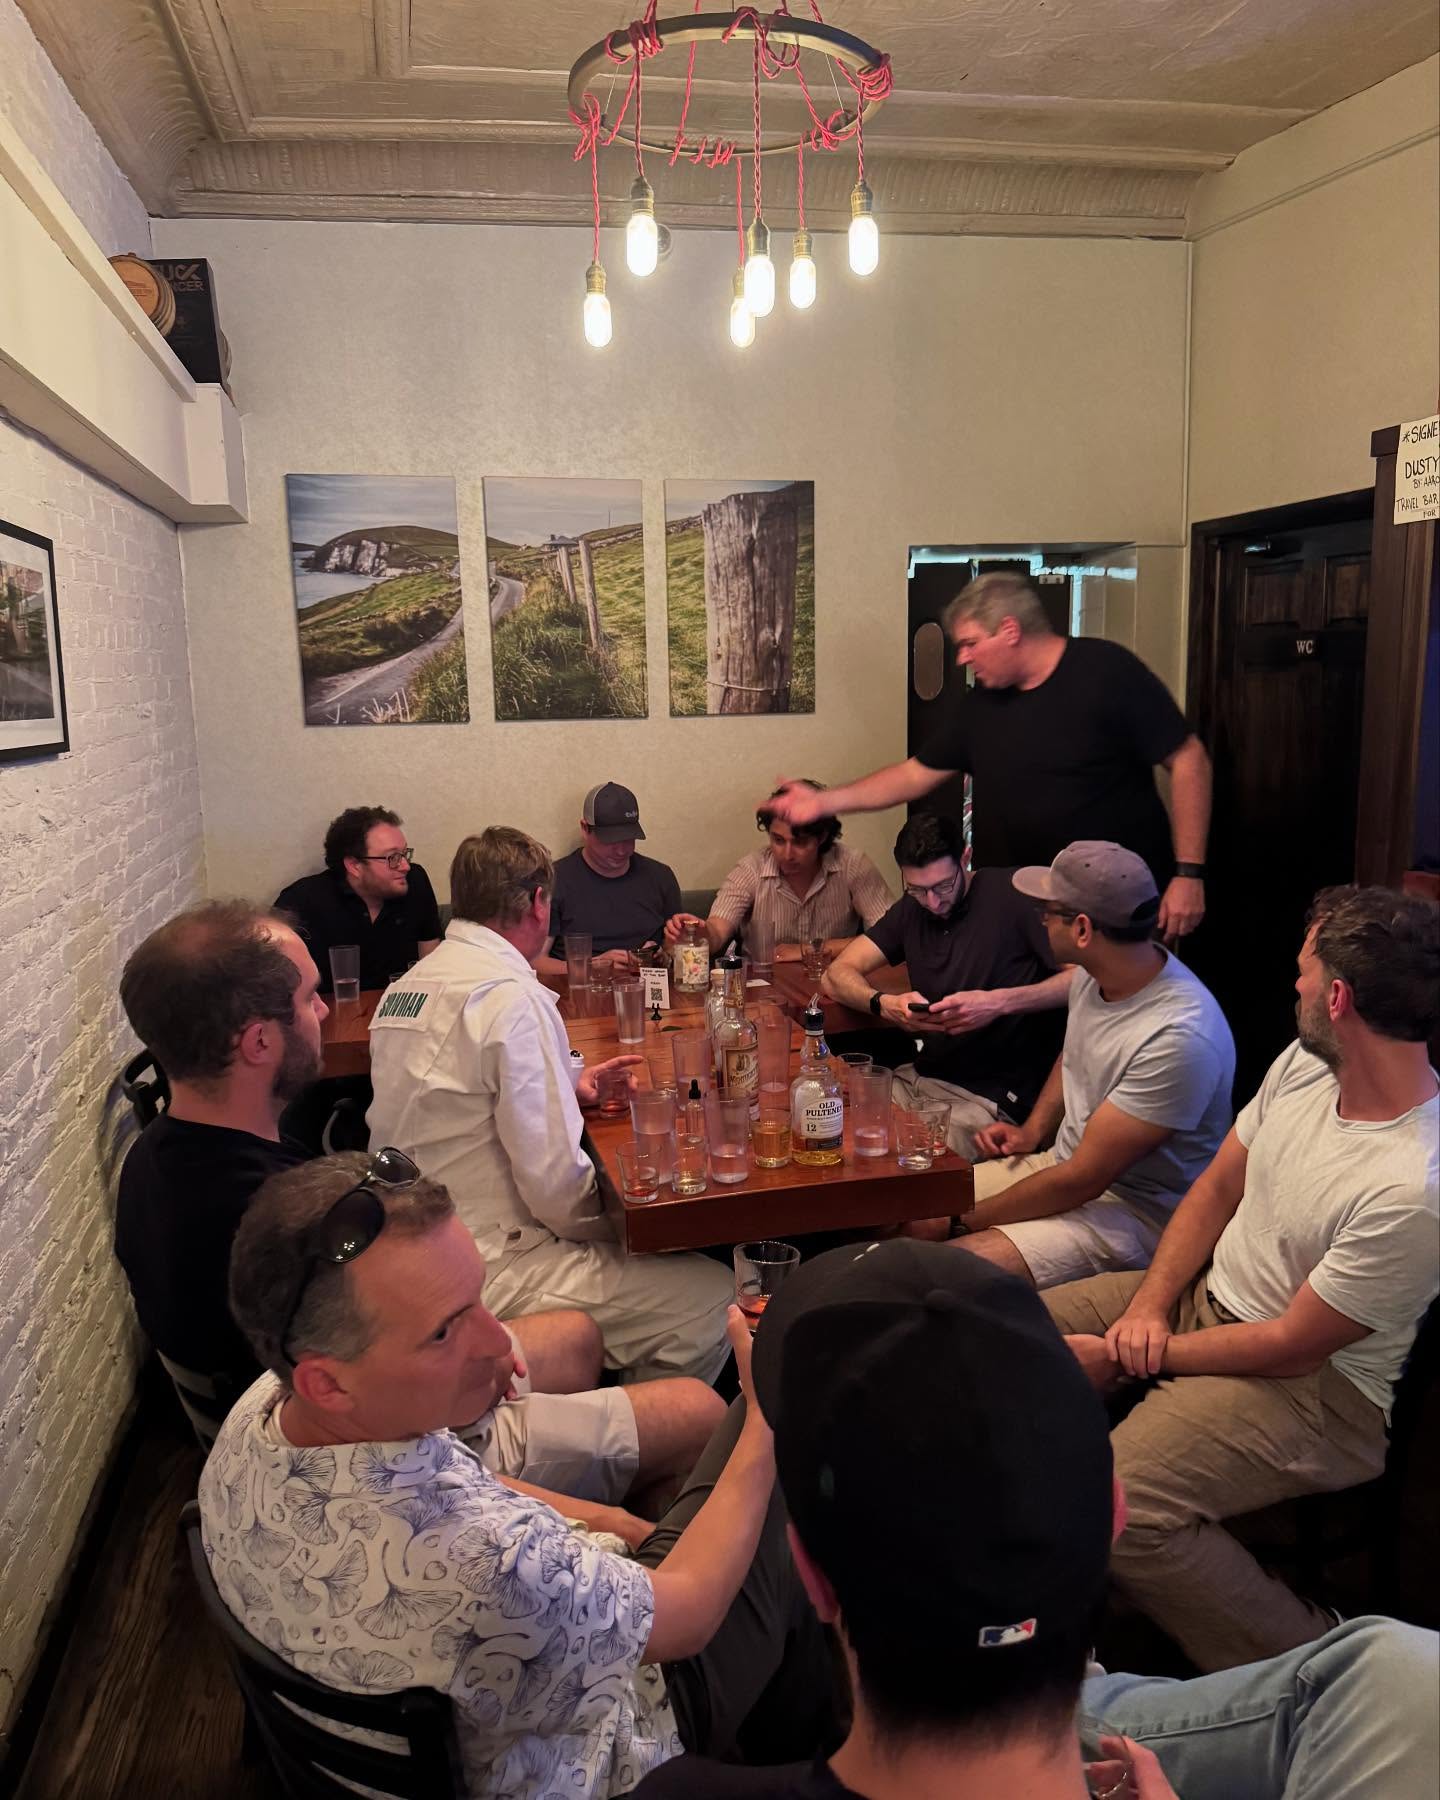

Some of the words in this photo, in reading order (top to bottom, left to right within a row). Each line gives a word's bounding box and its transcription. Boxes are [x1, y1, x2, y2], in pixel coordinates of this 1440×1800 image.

[152, 264, 202, 281] UCK
[1411, 420, 1440, 443] SIGNE
[1405, 455, 1440, 479] DUSTY
[1396, 496, 1419, 512] TRAVEL
[1423, 493, 1438, 506] BAR
[1296, 640, 1313, 654] WC
[806, 1105, 842, 1117] PULTENE
[819, 1101, 836, 1109] OLD
[807, 1123, 817, 1132] 12
